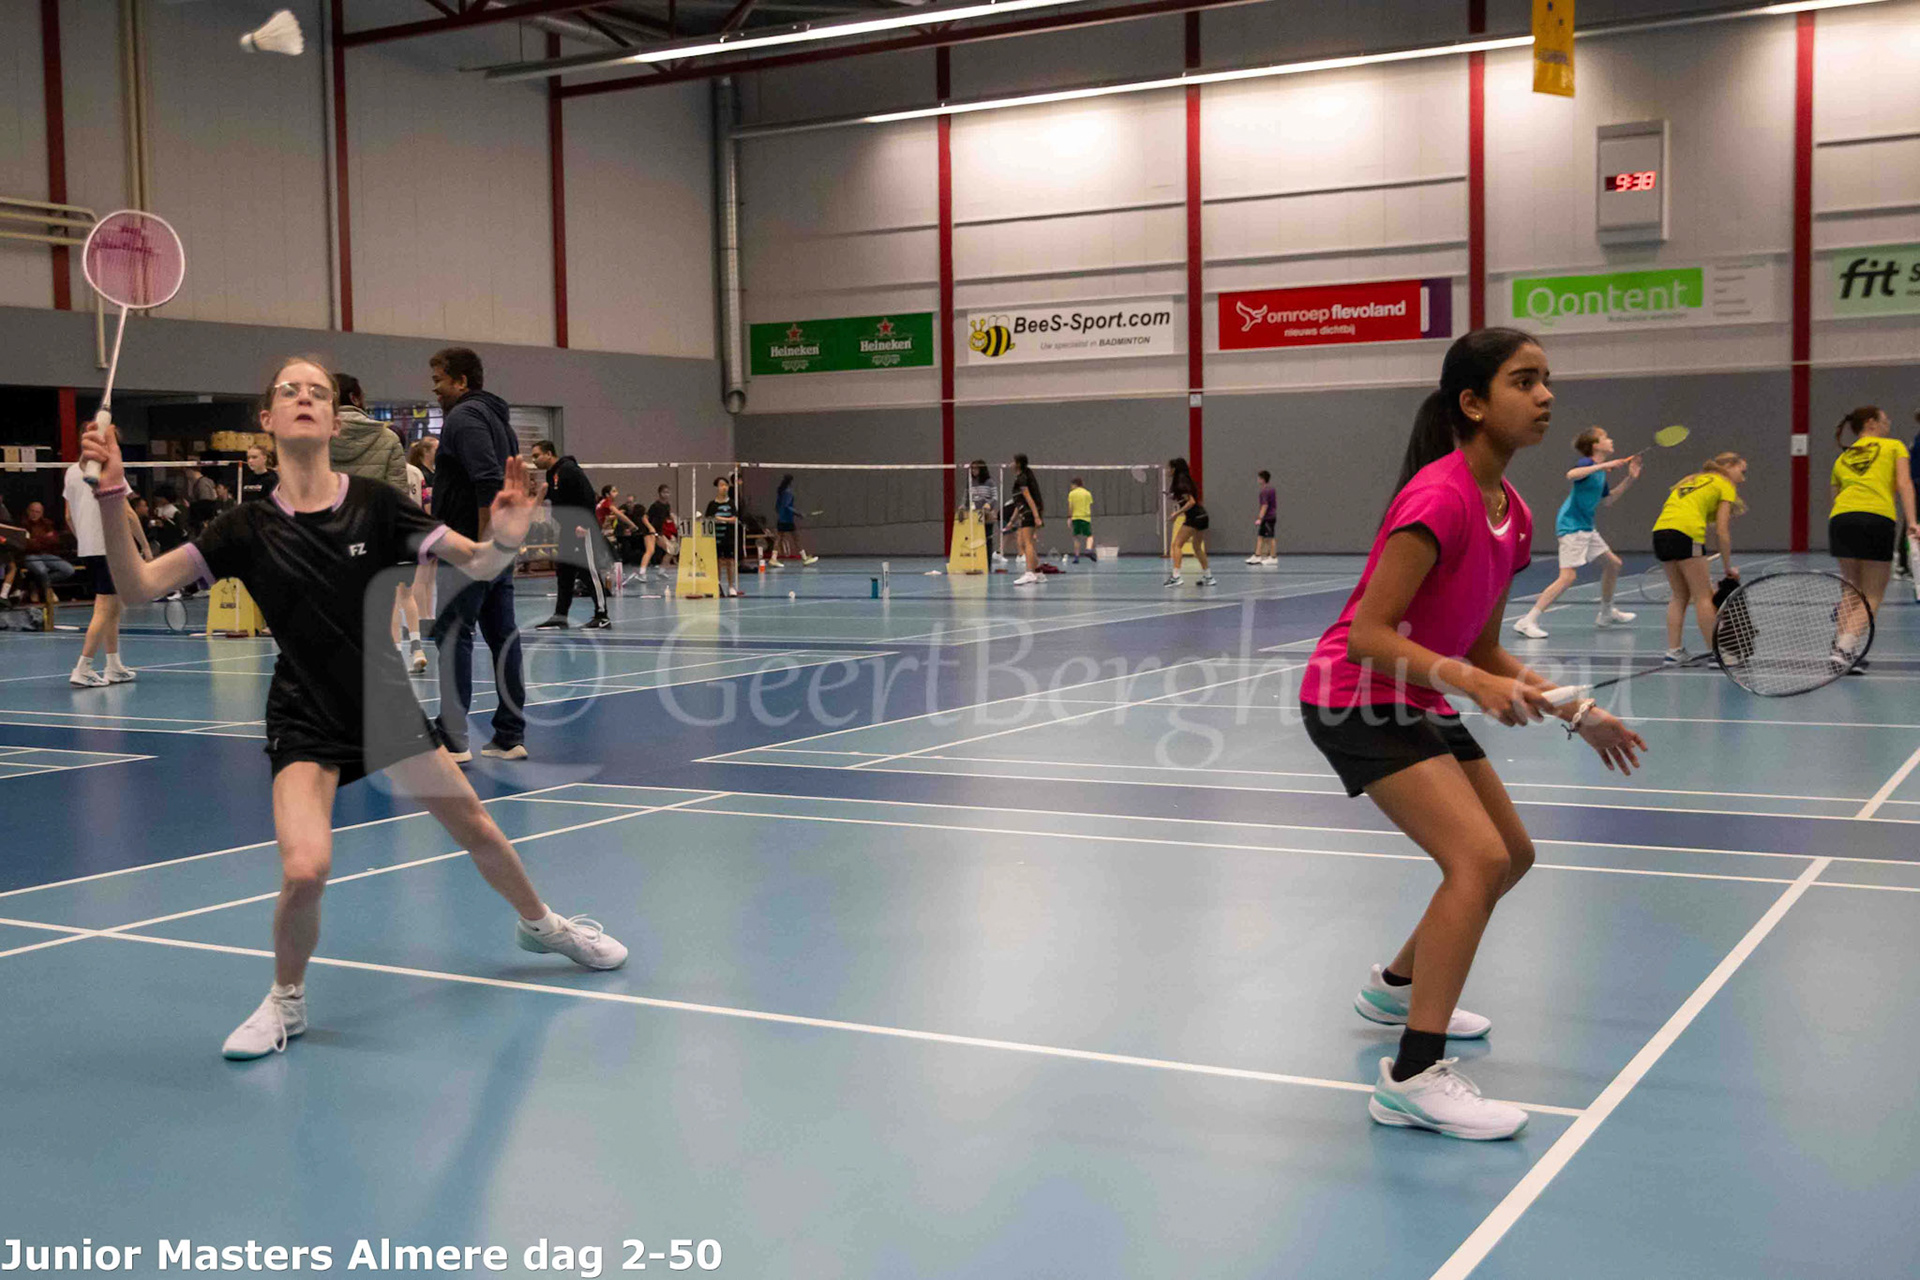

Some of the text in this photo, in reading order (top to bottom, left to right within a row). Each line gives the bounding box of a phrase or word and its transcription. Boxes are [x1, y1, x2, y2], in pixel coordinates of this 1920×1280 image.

[1616, 171, 1656, 192] 9:38
[1840, 257, 1899, 299] fit
[1527, 279, 1688, 326] Qontent
[1267, 300, 1407, 323] omroep flevoland
[1014, 312, 1171, 334] BeeS-Sport.com
[1284, 324, 1356, 337] nieuws dichtbij
[860, 339, 912, 352] Heineken
[1099, 336, 1151, 347] BADMINTON
[771, 344, 820, 357] Heineken
[680, 520, 714, 535] 11 10
[349, 542, 367, 557] FZ
